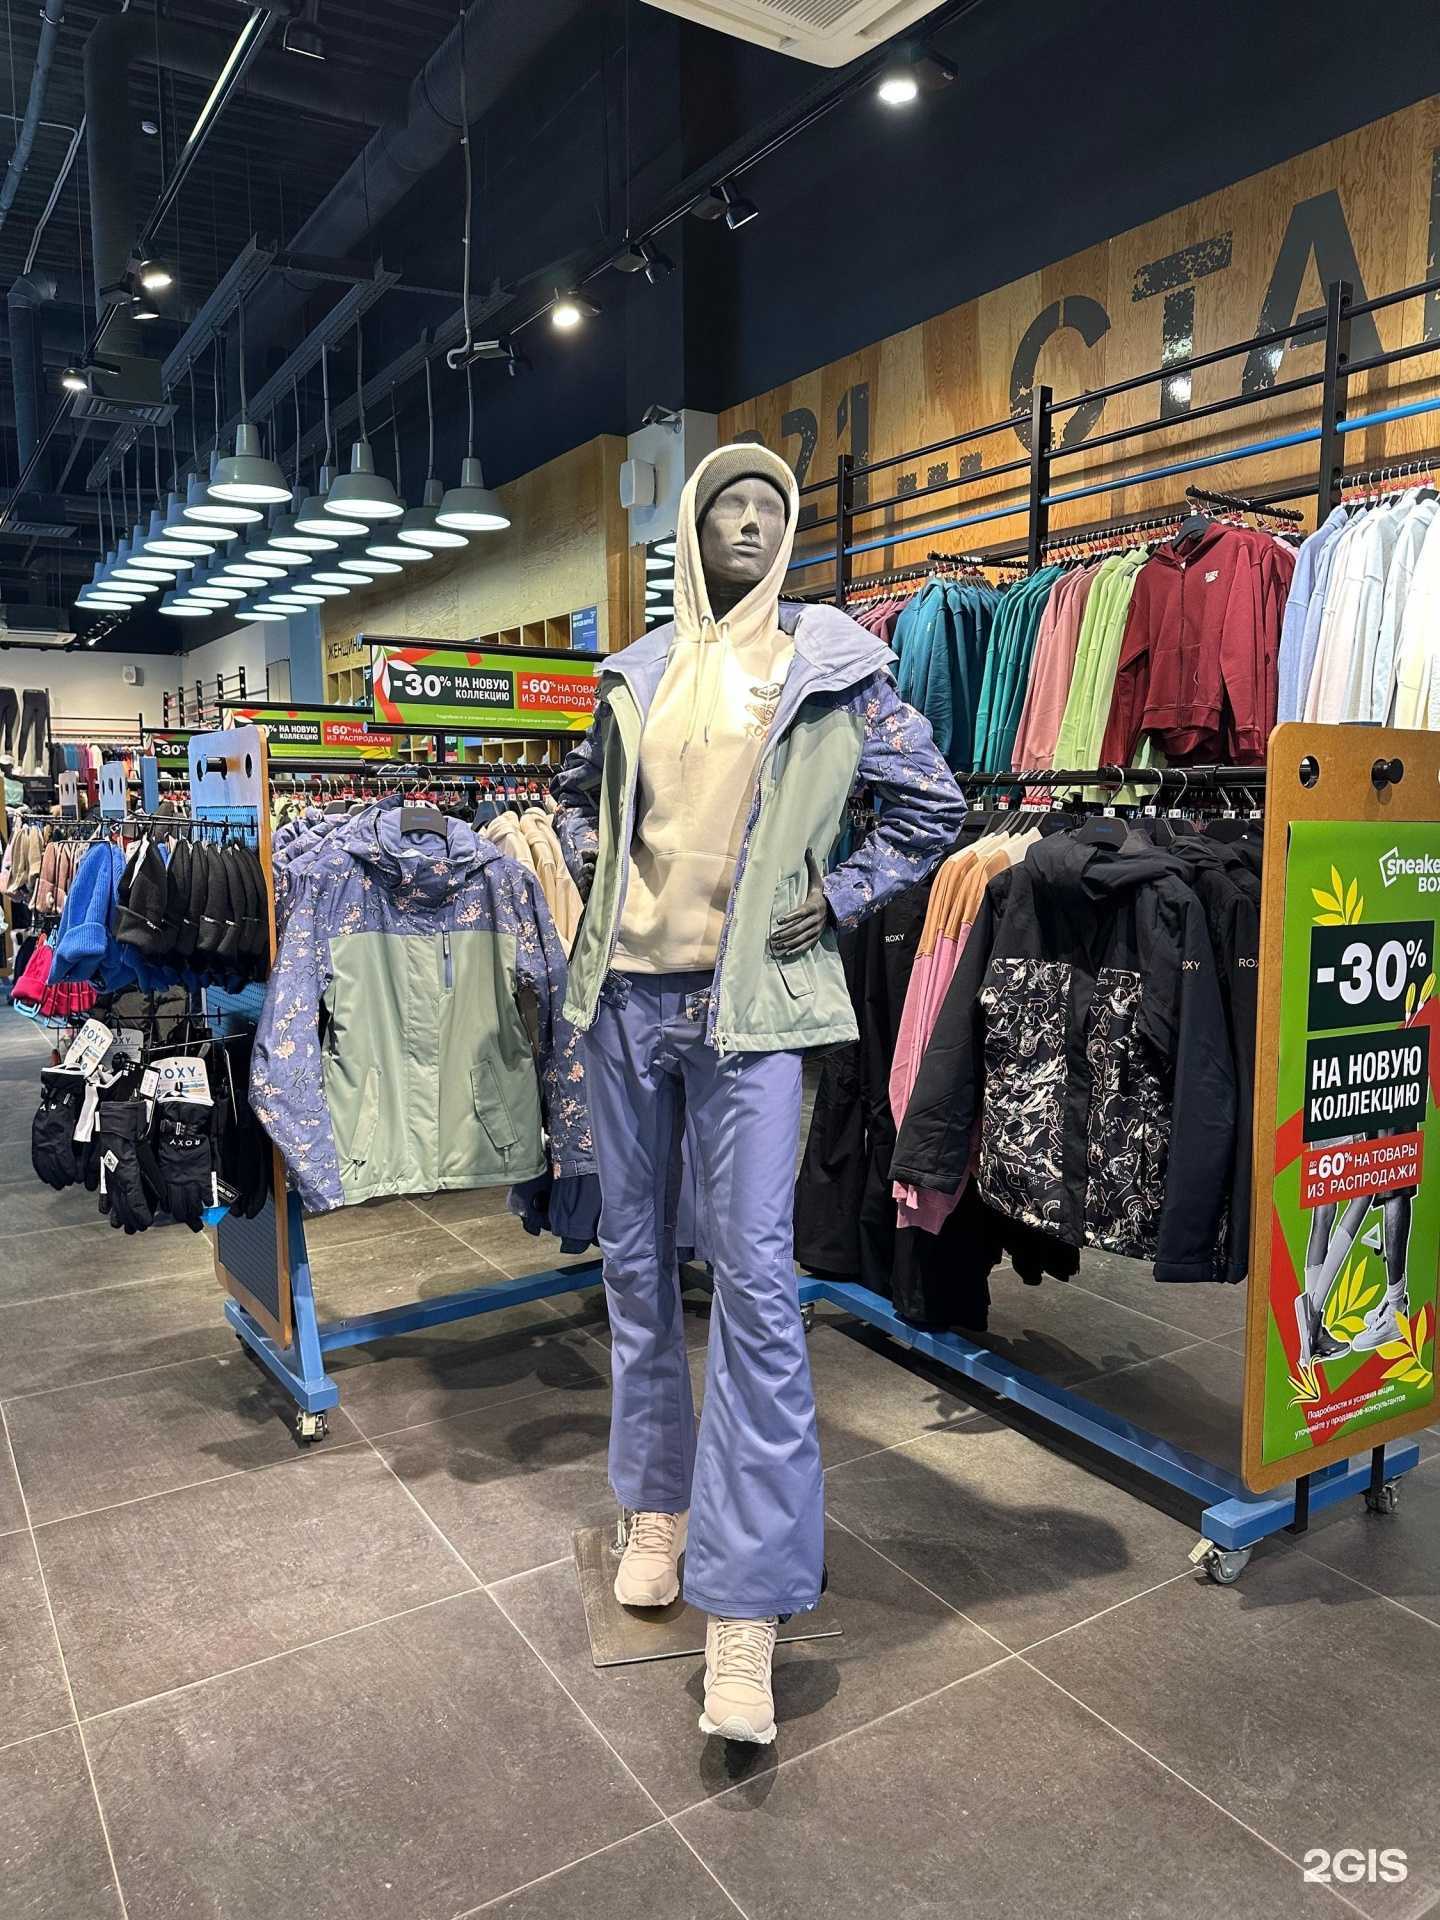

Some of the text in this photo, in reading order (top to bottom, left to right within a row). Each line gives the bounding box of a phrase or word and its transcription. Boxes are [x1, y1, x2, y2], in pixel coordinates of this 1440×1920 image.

[393, 673, 510, 697] -30% НА НОВУЮ
[557, 684, 570, 693] НА
[571, 684, 597, 694] ТОВА
[455, 689, 510, 702] КОЛЛЕКЦИЮ
[522, 693, 536, 703] ИЗ
[279, 724, 290, 733] НА
[291, 725, 318, 734] НОВУЮ
[279, 733, 319, 741] КОЛЛЕКЦИЮ
[339, 734, 392, 744] РАСПРОДАЖИ
[156, 744, 186, 755] -30%
[1386, 853, 1440, 875] sneake
[884, 932, 905, 943] ROXY
[1182, 959, 1201, 971] XY
[1316, 939, 1427, 1005] -30%
[81, 1024, 106, 1048] ROXY
[112, 1036, 131, 1045] OXY
[159, 1066, 197, 1080] OXY
[1312, 1045, 1422, 1091] НА НОВУЮ
[1310, 1082, 1420, 1124] КОЛЛЕКЦИЮ
[169, 1138, 201, 1147] ROXY
[1308, 1151, 1353, 1179] -60%
[1354, 1153, 1371, 1168] НА
[1371, 1142, 1418, 1163] ТОВАРЫ
[1307, 1162, 1417, 1199] ИЗ РАСПРОДАЖИ
[1307, 1400, 1348, 1420] Подробности
